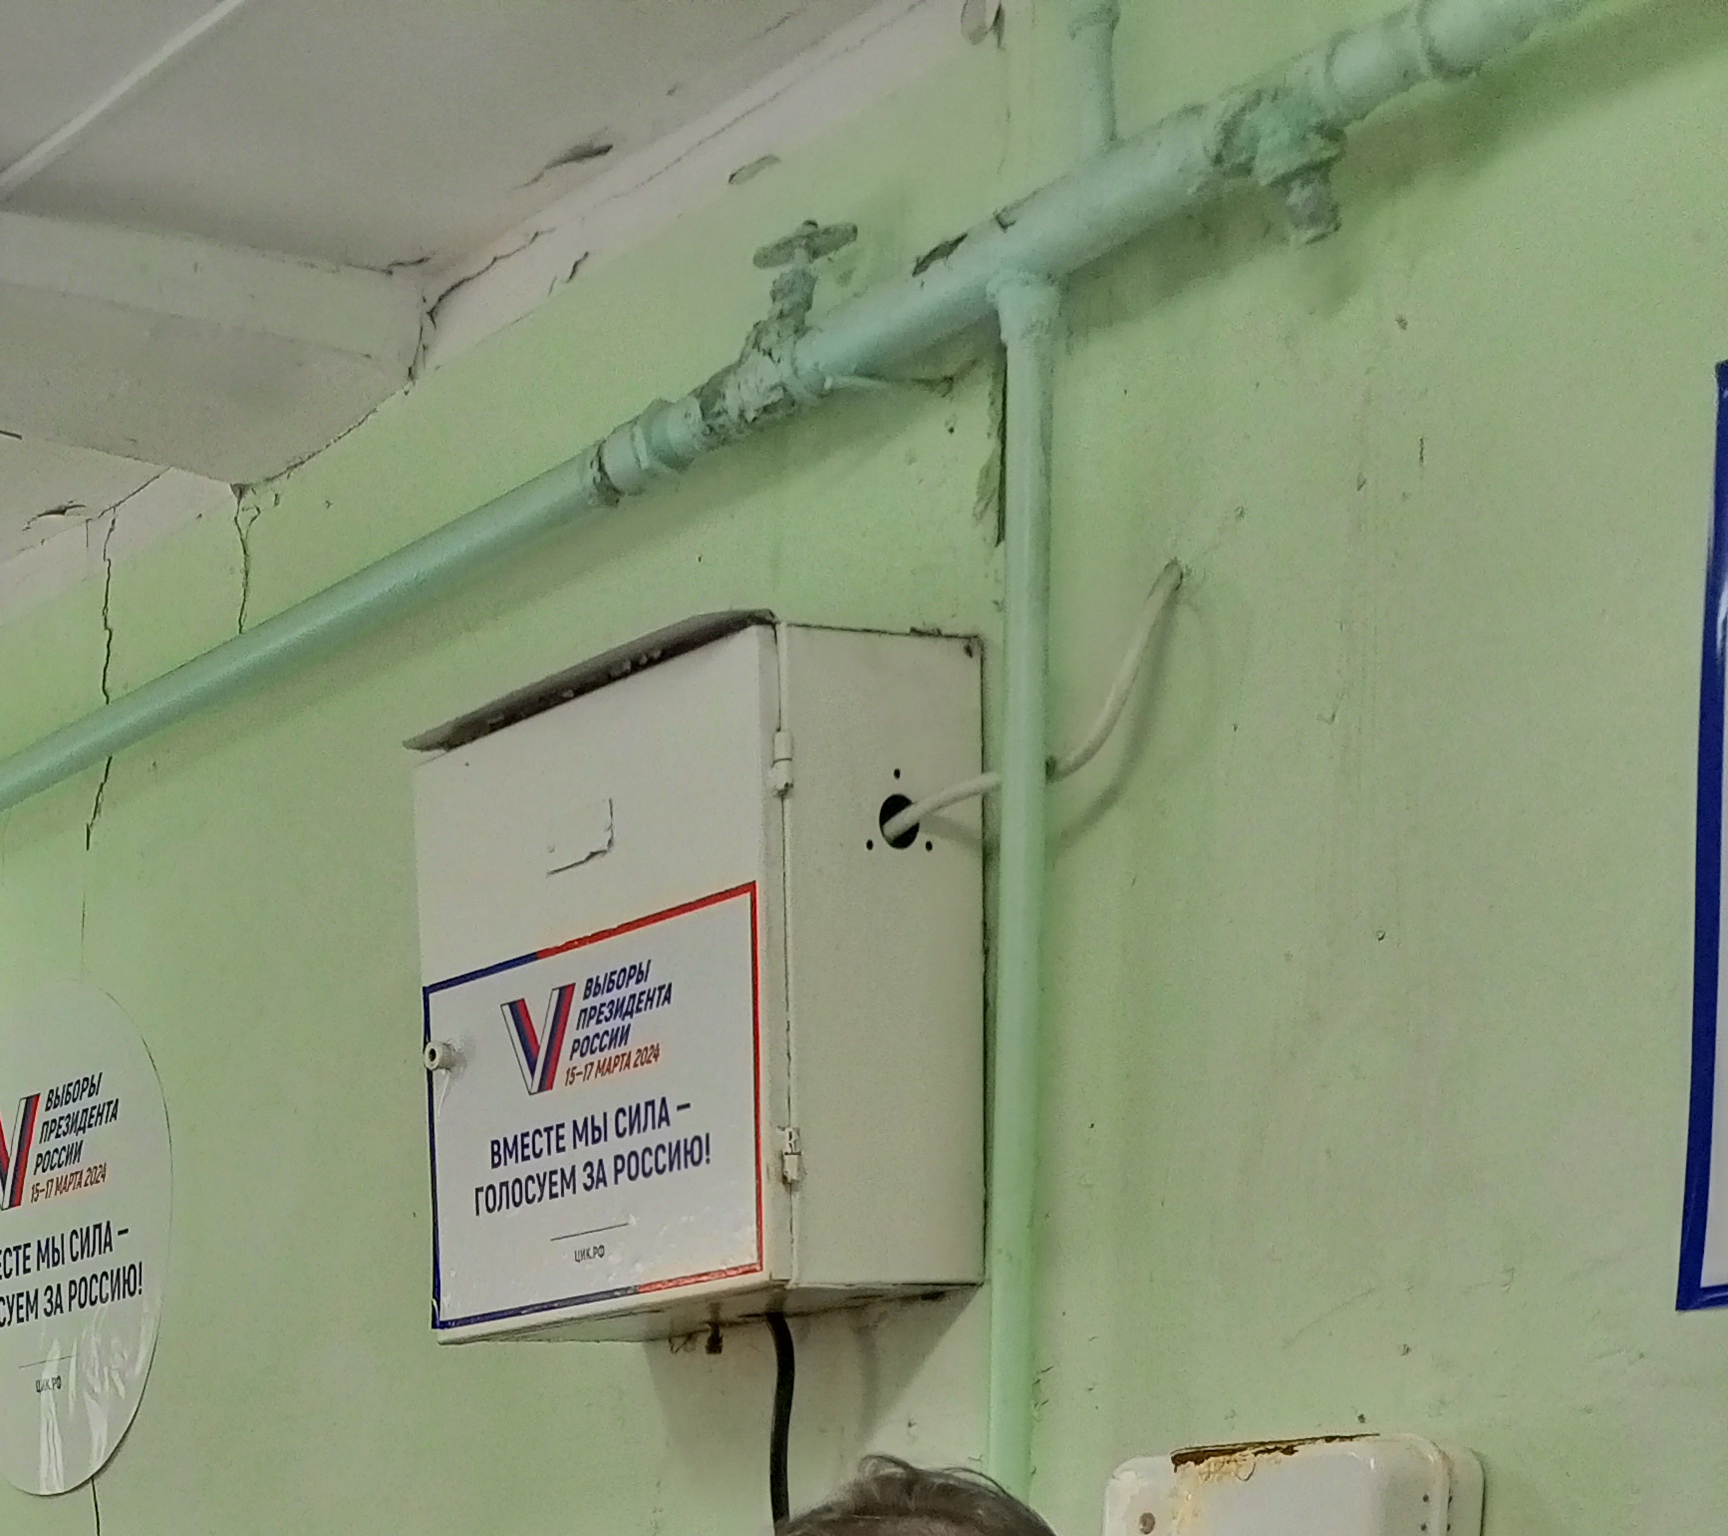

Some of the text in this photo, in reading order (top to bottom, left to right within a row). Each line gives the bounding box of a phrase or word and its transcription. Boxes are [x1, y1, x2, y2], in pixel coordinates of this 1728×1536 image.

[582, 958, 652, 1001] ВЫБОРЫ
[575, 981, 673, 1031] ПРЕЗИДЕНТА
[568, 1023, 631, 1061] РОССИИ
[594, 1053, 632, 1079] МАРТА
[632, 1043, 661, 1069] 2024
[44, 1071, 104, 1113] ВЫБОРЫ
[38, 1097, 120, 1145] ПРЕЗИДЕНТА
[489, 1121, 566, 1170] ВМЕСТЕ
[572, 1111, 608, 1150] МЫ
[614, 1096, 671, 1139] СИЛА
[32, 1139, 84, 1176] РОССИИ
[54, 1169, 84, 1197] МАРТА
[83, 1162, 107, 1188] 2024
[474, 1131, 711, 1217] ГОЛОСУЕМ ЗА РОССИЮ!
[36, 1233, 66, 1271] МЫ
[69, 1220, 114, 1262] СИЛА
[42, 1283, 65, 1318] ЗА
[68, 1261, 144, 1313] РОССИЮ!
